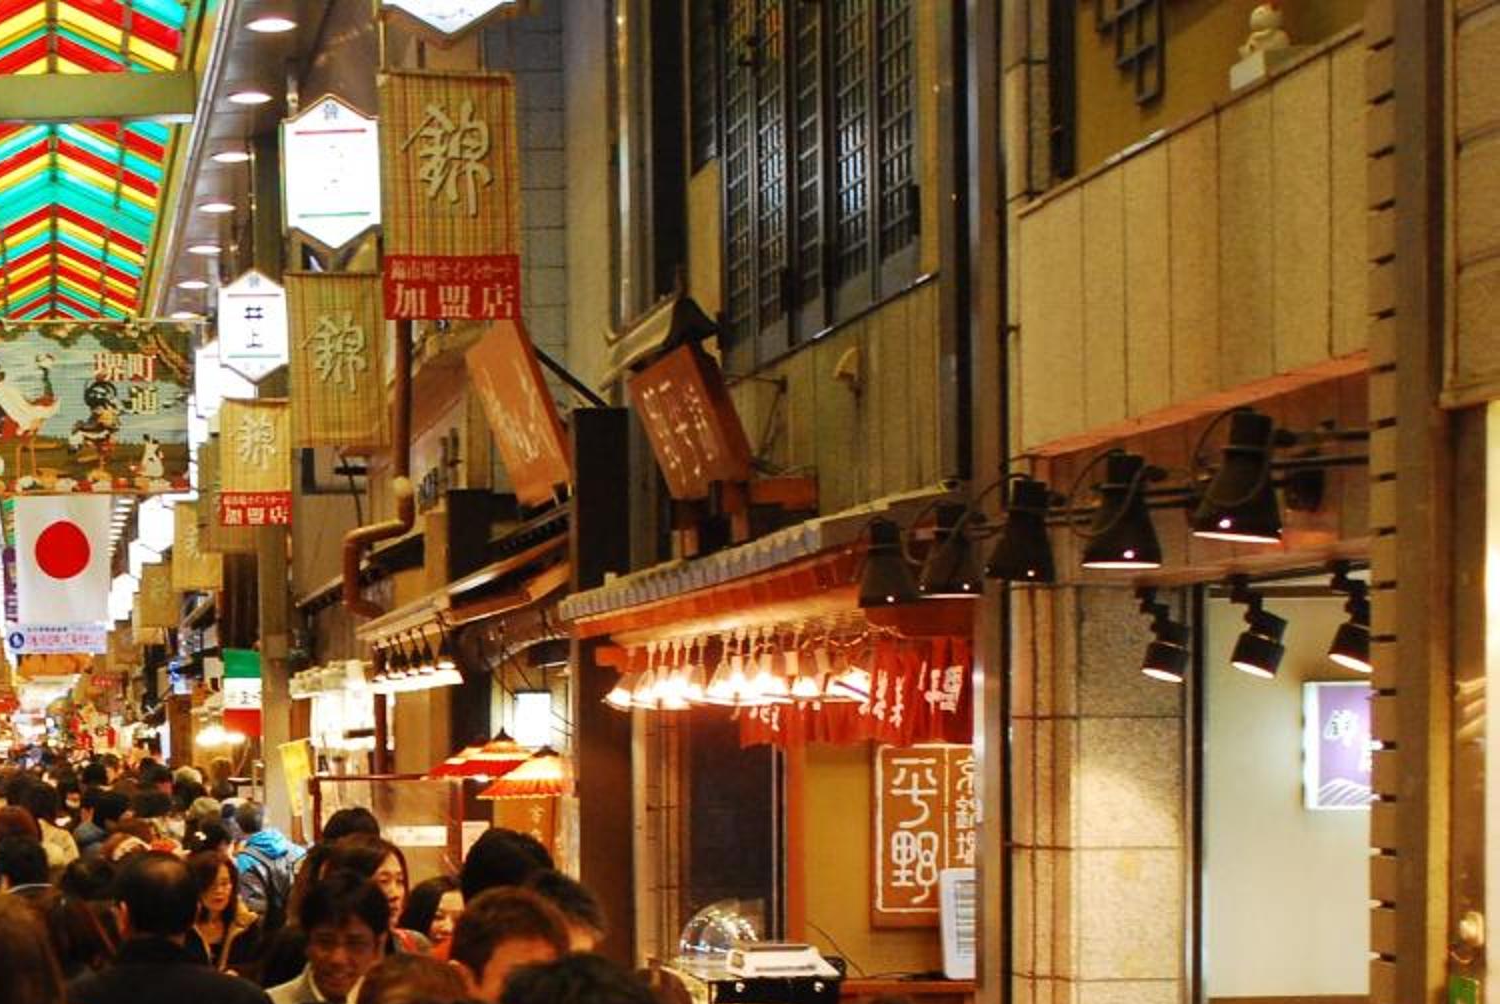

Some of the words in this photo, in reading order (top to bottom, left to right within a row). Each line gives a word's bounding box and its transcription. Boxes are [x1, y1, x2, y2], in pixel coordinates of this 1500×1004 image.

[401, 99, 495, 218] 錦
[244, 304, 264, 350] 井上
[393, 283, 514, 319] 加盟店
[300, 315, 368, 394] 錦
[233, 412, 278, 470] 錦
